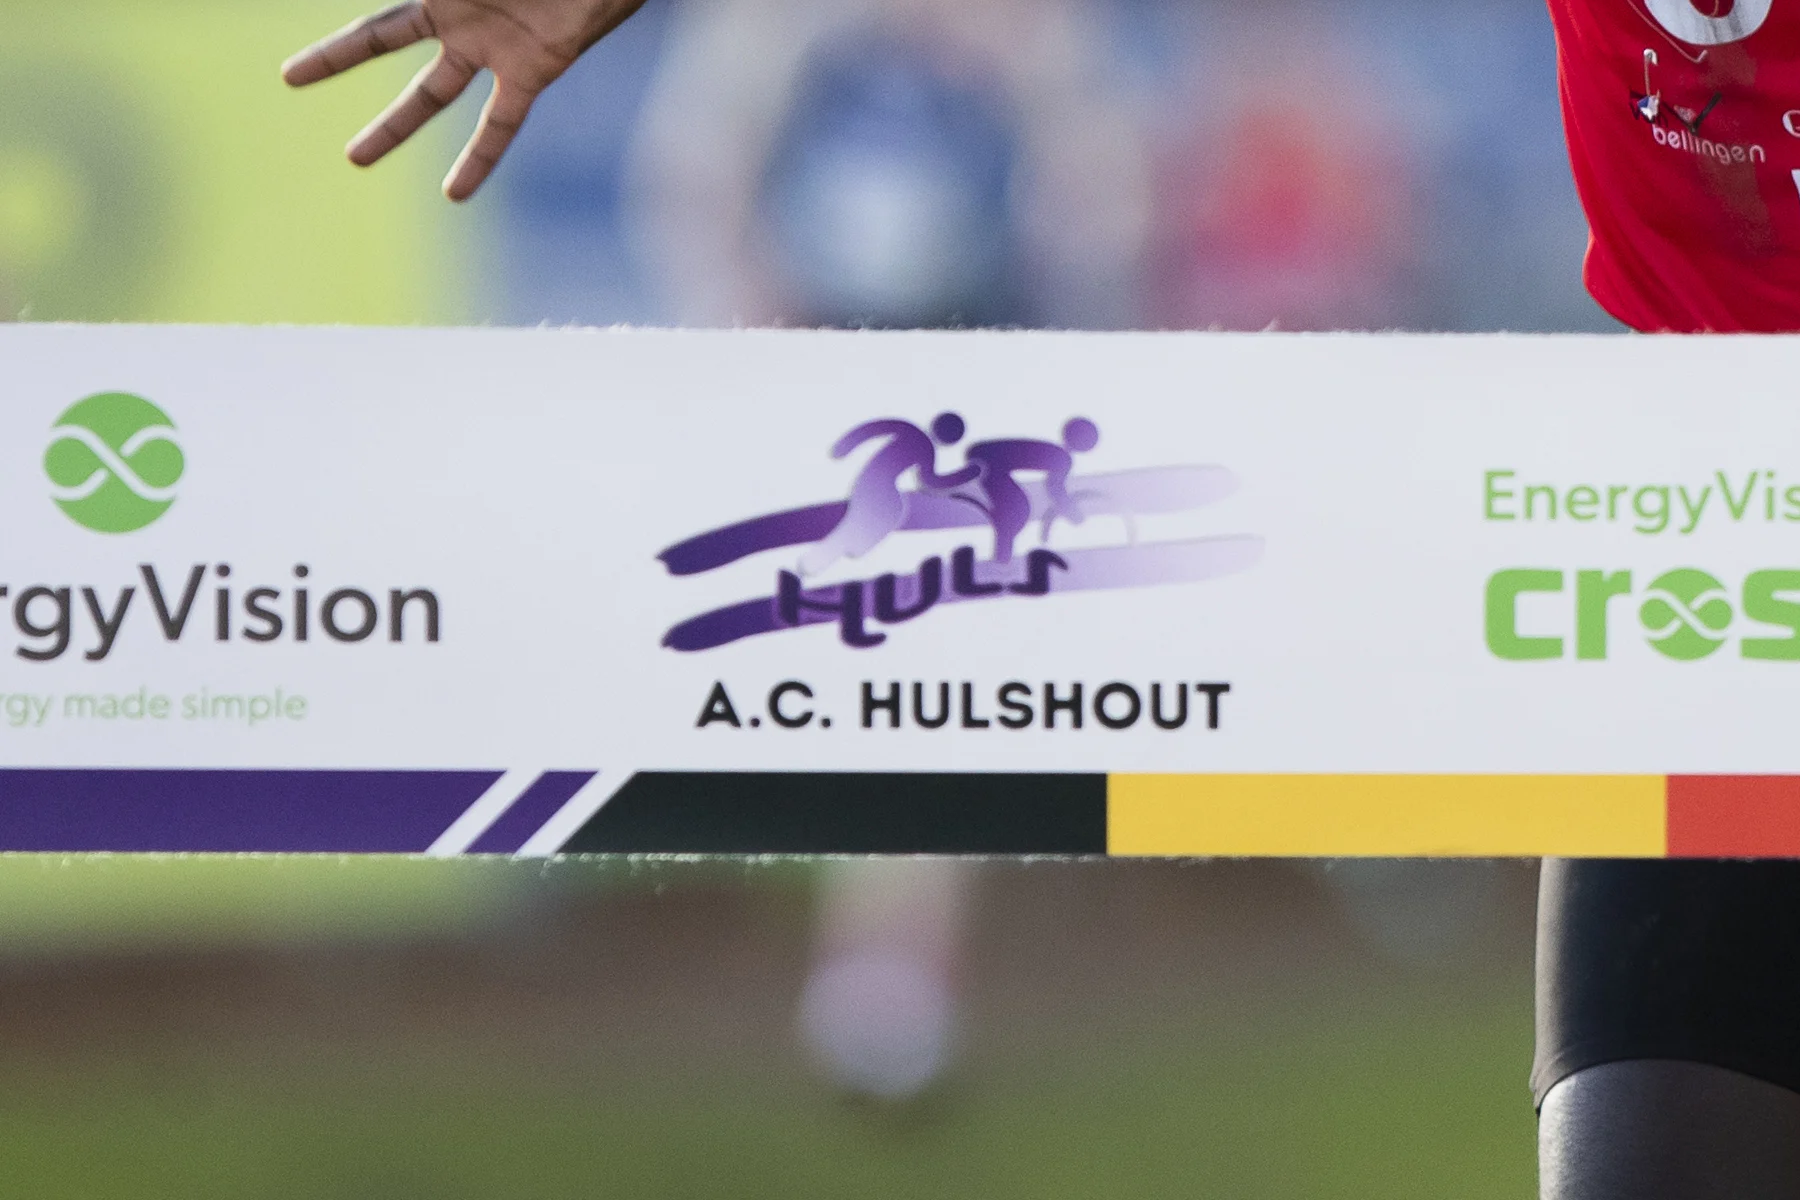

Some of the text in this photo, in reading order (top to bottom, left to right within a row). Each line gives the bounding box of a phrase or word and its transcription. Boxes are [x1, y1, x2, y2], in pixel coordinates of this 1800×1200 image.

[1652, 122, 1766, 165] bellingen
[62, 684, 171, 720] made
[180, 684, 308, 726] simple
[695, 680, 1232, 731] A.C. HULSHOUT
